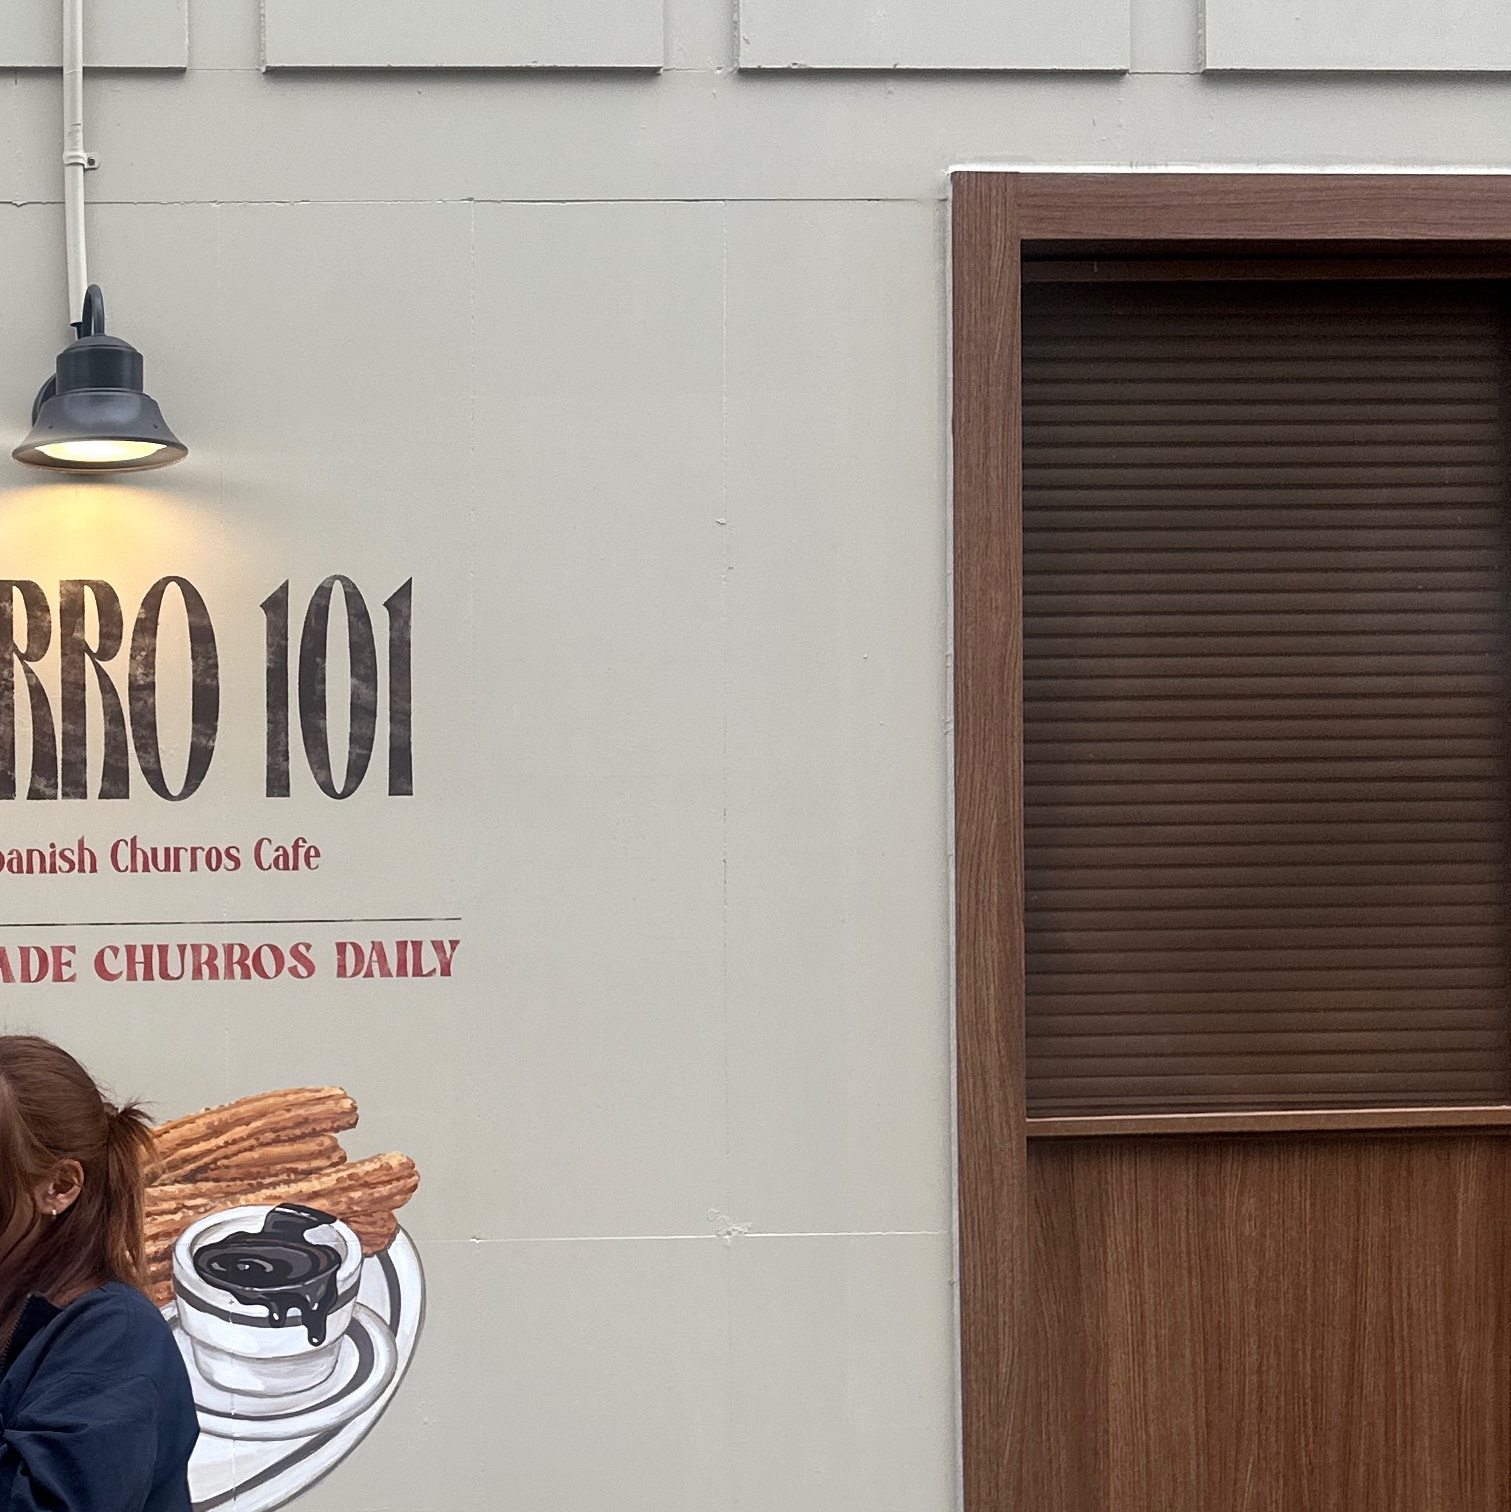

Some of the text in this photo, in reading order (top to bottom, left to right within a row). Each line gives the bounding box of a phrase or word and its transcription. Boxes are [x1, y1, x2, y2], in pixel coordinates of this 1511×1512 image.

[260, 575, 414, 800] 101
[110, 835, 242, 874] Churros
[254, 837, 322, 871] Cafe
[93, 942, 317, 983] CHURROS
[335, 939, 461, 978] DAILY
